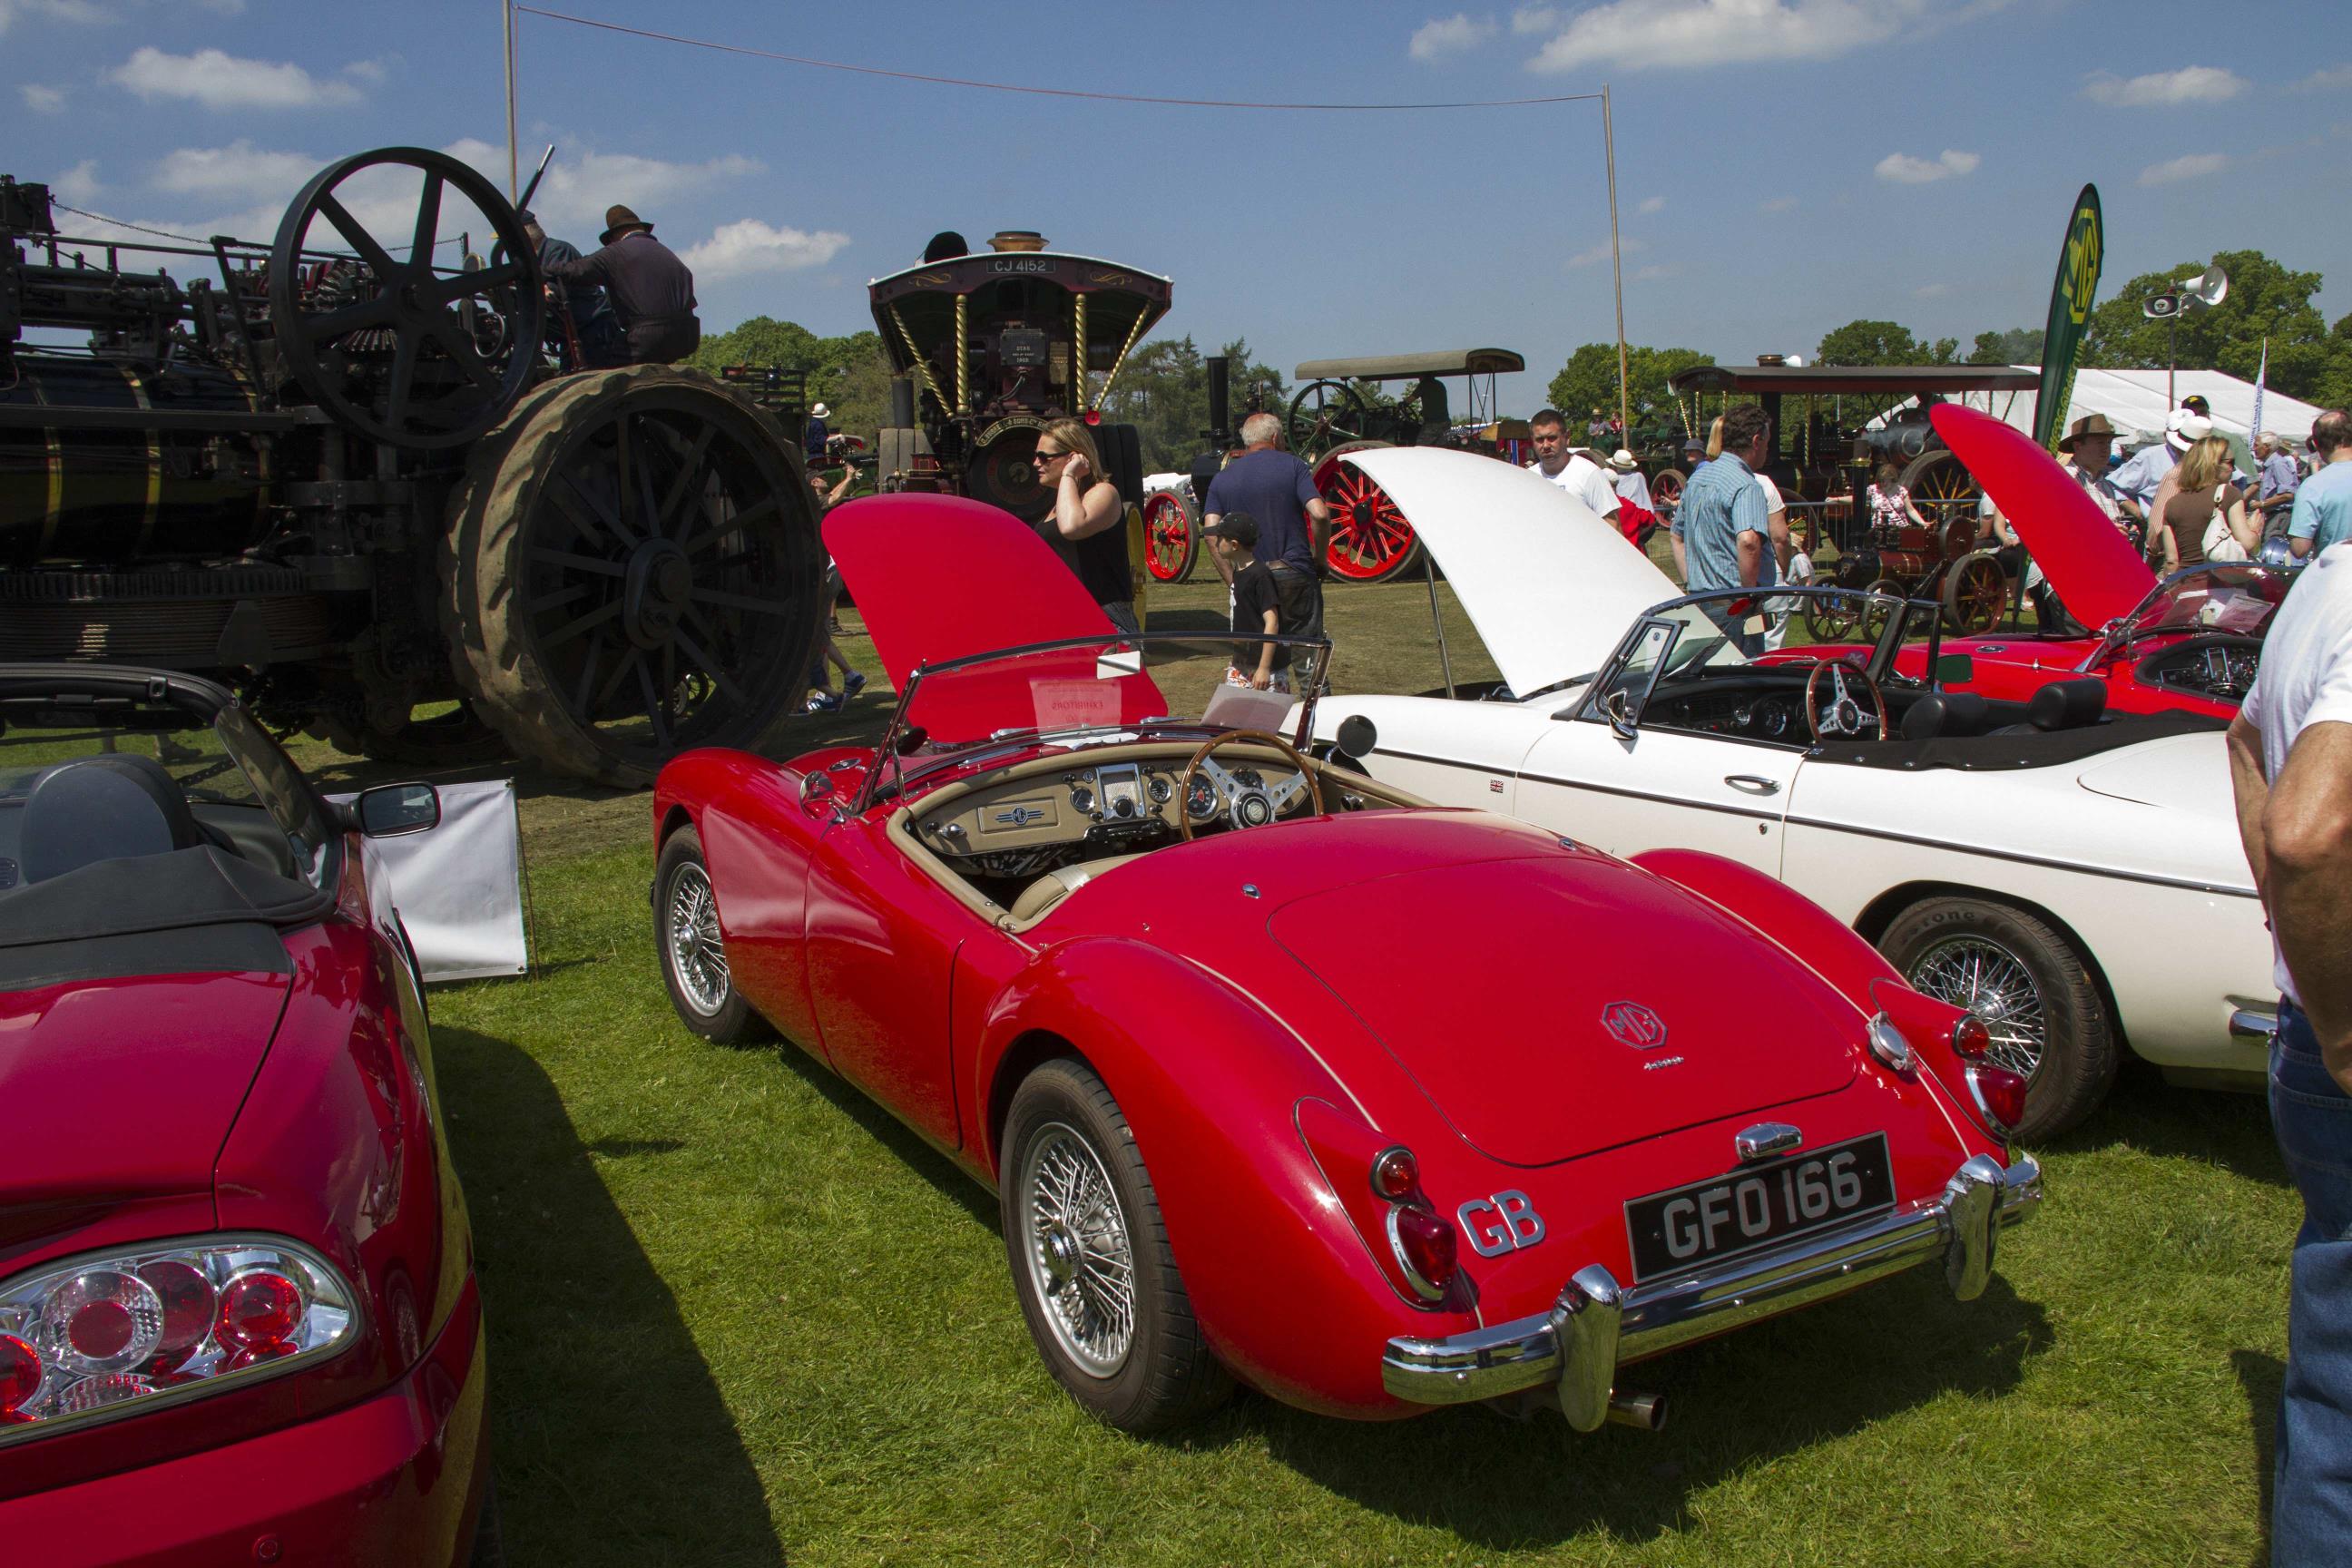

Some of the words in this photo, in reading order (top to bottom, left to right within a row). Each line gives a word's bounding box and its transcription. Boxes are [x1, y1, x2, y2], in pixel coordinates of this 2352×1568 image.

[995, 260, 1012, 271] CJ
[1016, 260, 1046, 271] 4152
[2063, 218, 2096, 314] MG
[1605, 1004, 1662, 1045] MG
[1457, 1190, 1546, 1259] GB
[1663, 1178, 1770, 1259] GFO
[1782, 1152, 1862, 1225] 166
